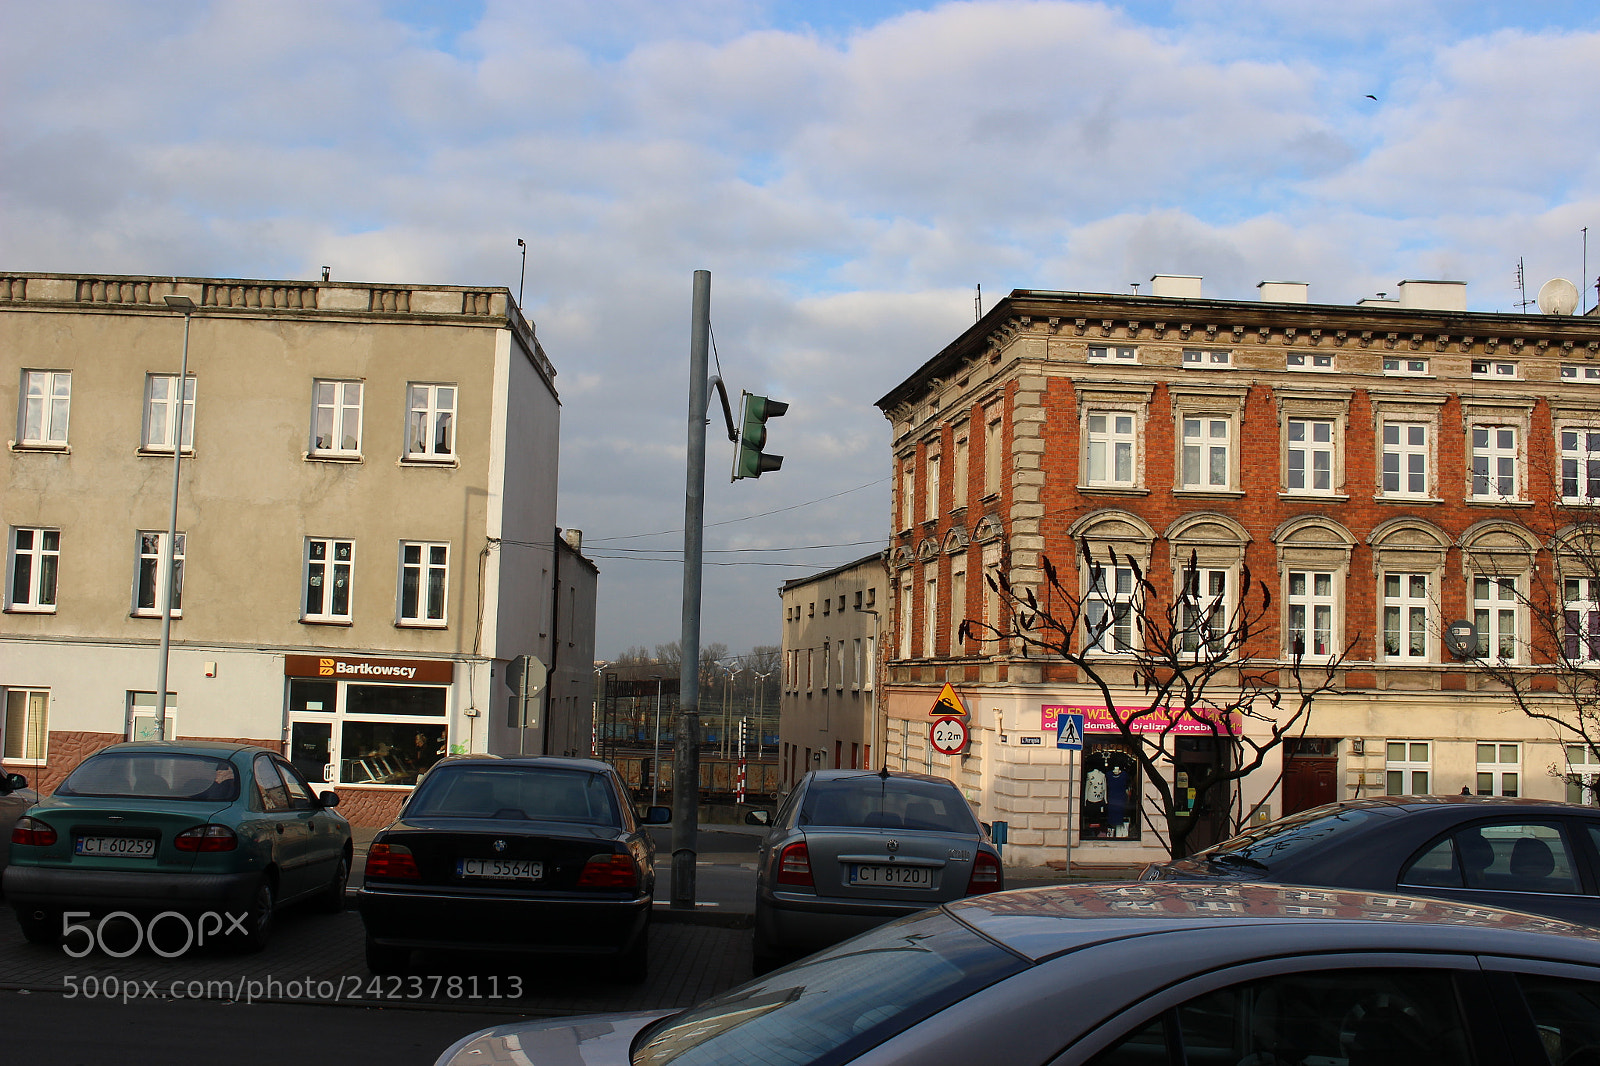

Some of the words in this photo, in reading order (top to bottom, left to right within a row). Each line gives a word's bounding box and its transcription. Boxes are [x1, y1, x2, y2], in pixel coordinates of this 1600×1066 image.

[336, 662, 417, 679] Bartkowscy
[1132, 723, 1177, 731] bielizn,
[1178, 723, 1213, 731] torebk
[85, 838, 104, 852] CT
[110, 840, 153, 854] 60259
[466, 860, 488, 875] CT
[493, 861, 540, 877] 5564G
[860, 867, 880, 880] CT
[885, 868, 928, 883] 8120J
